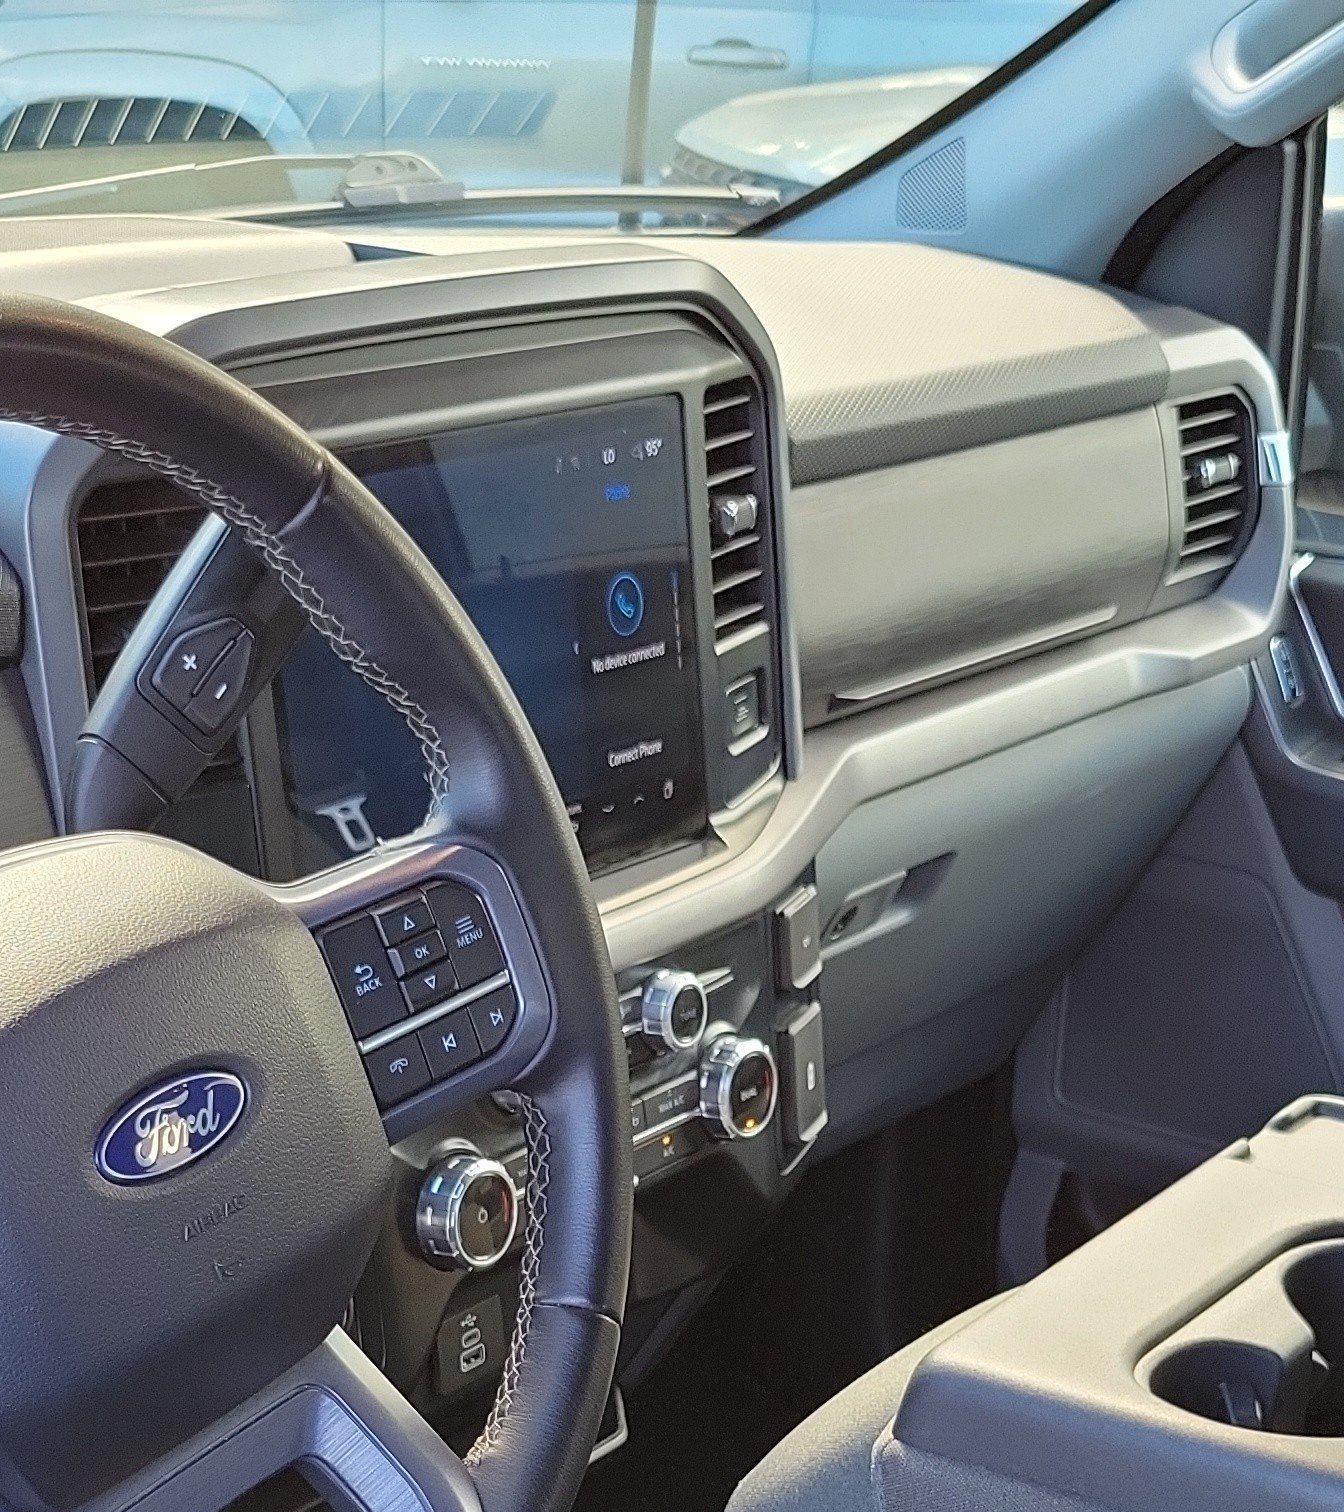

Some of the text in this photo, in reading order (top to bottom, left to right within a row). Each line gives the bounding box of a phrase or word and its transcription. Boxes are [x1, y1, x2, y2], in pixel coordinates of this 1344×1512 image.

[592, 641, 665, 674] No device connected
[608, 740, 662, 767] Connect Phone
[456, 927, 484, 949] MENU
[414, 944, 430, 959] OK
[356, 976, 383, 997] BACK
[134, 1088, 221, 1168] Ford
